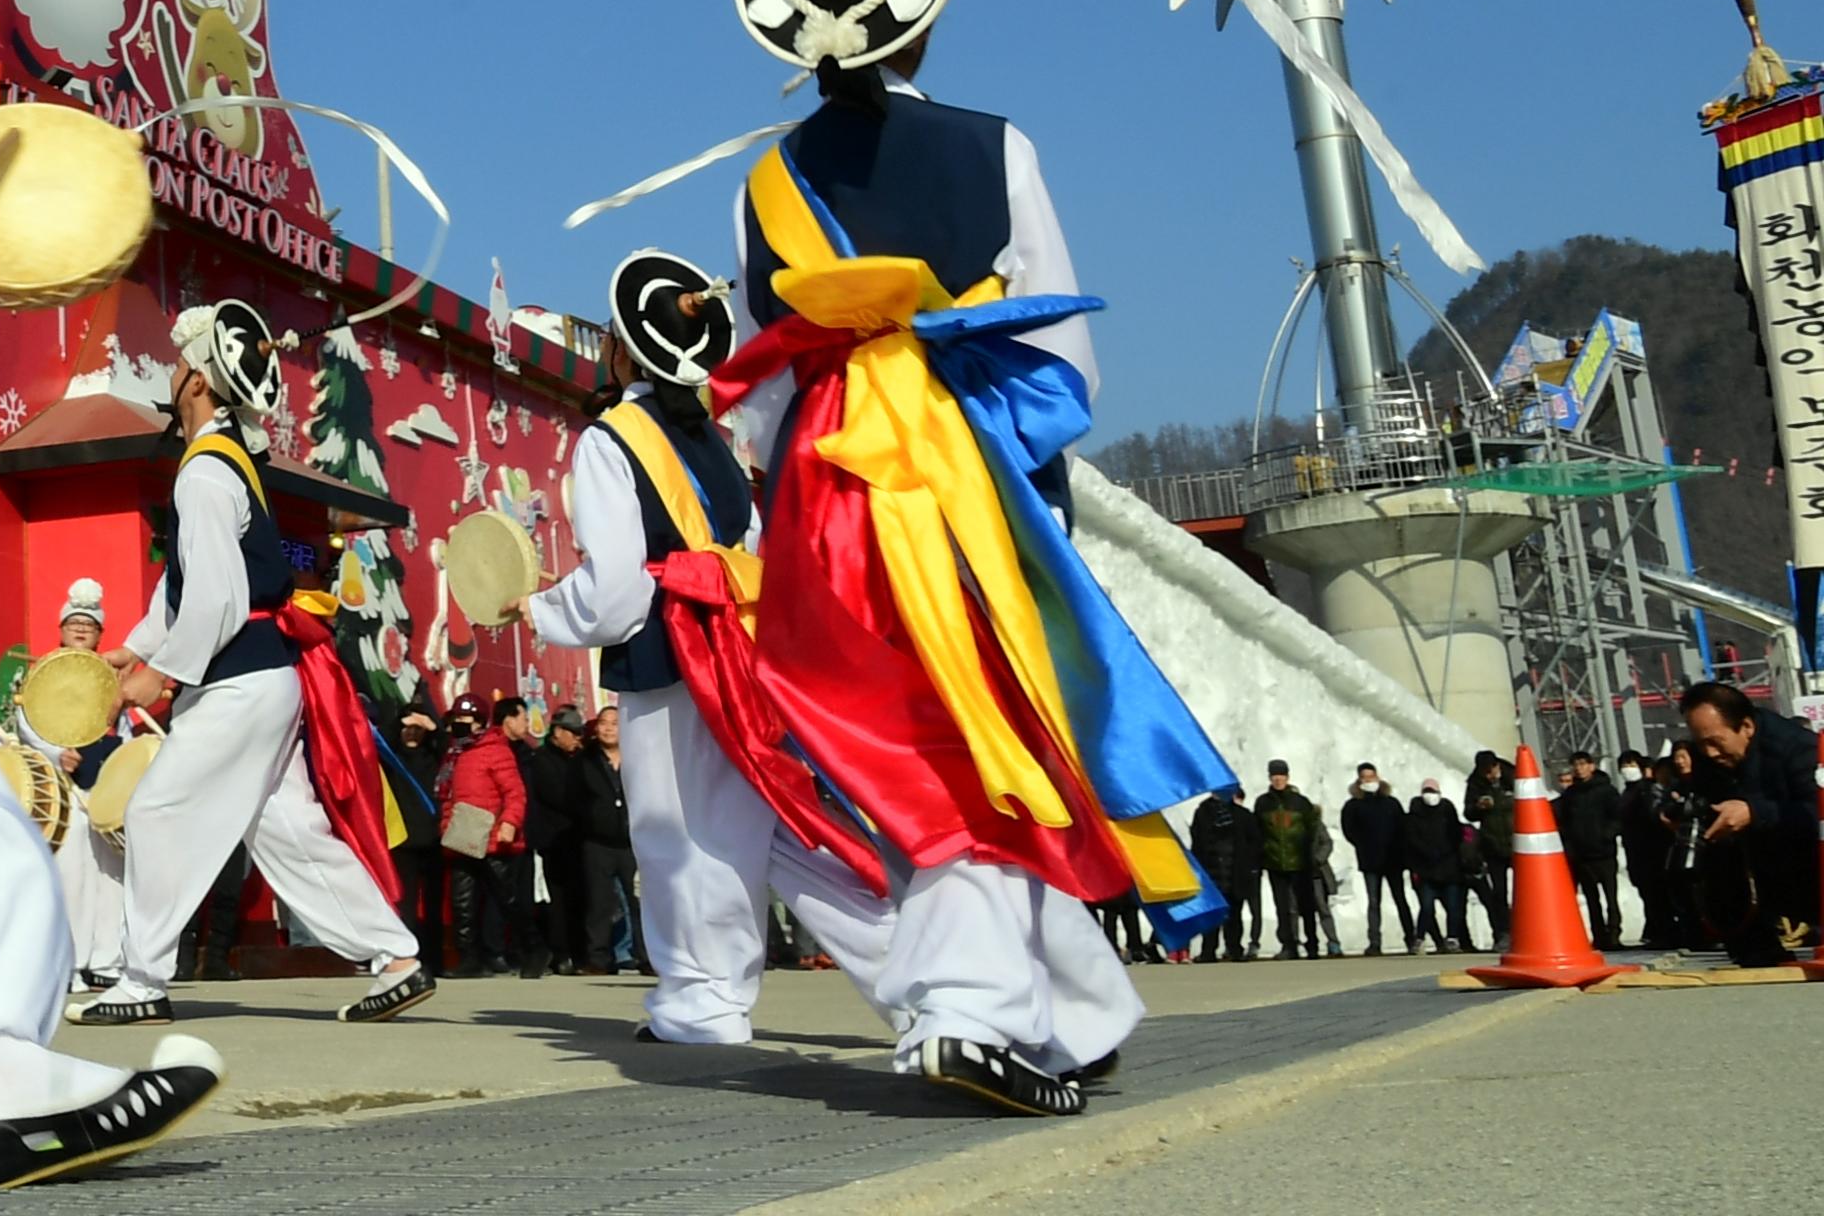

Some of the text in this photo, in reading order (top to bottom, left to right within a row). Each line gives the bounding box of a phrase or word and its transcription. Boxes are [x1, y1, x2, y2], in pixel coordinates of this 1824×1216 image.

[95, 75, 278, 203] SANTA CLAUS
[190, 171, 259, 244] POST
[259, 208, 343, 283] OFFICE
